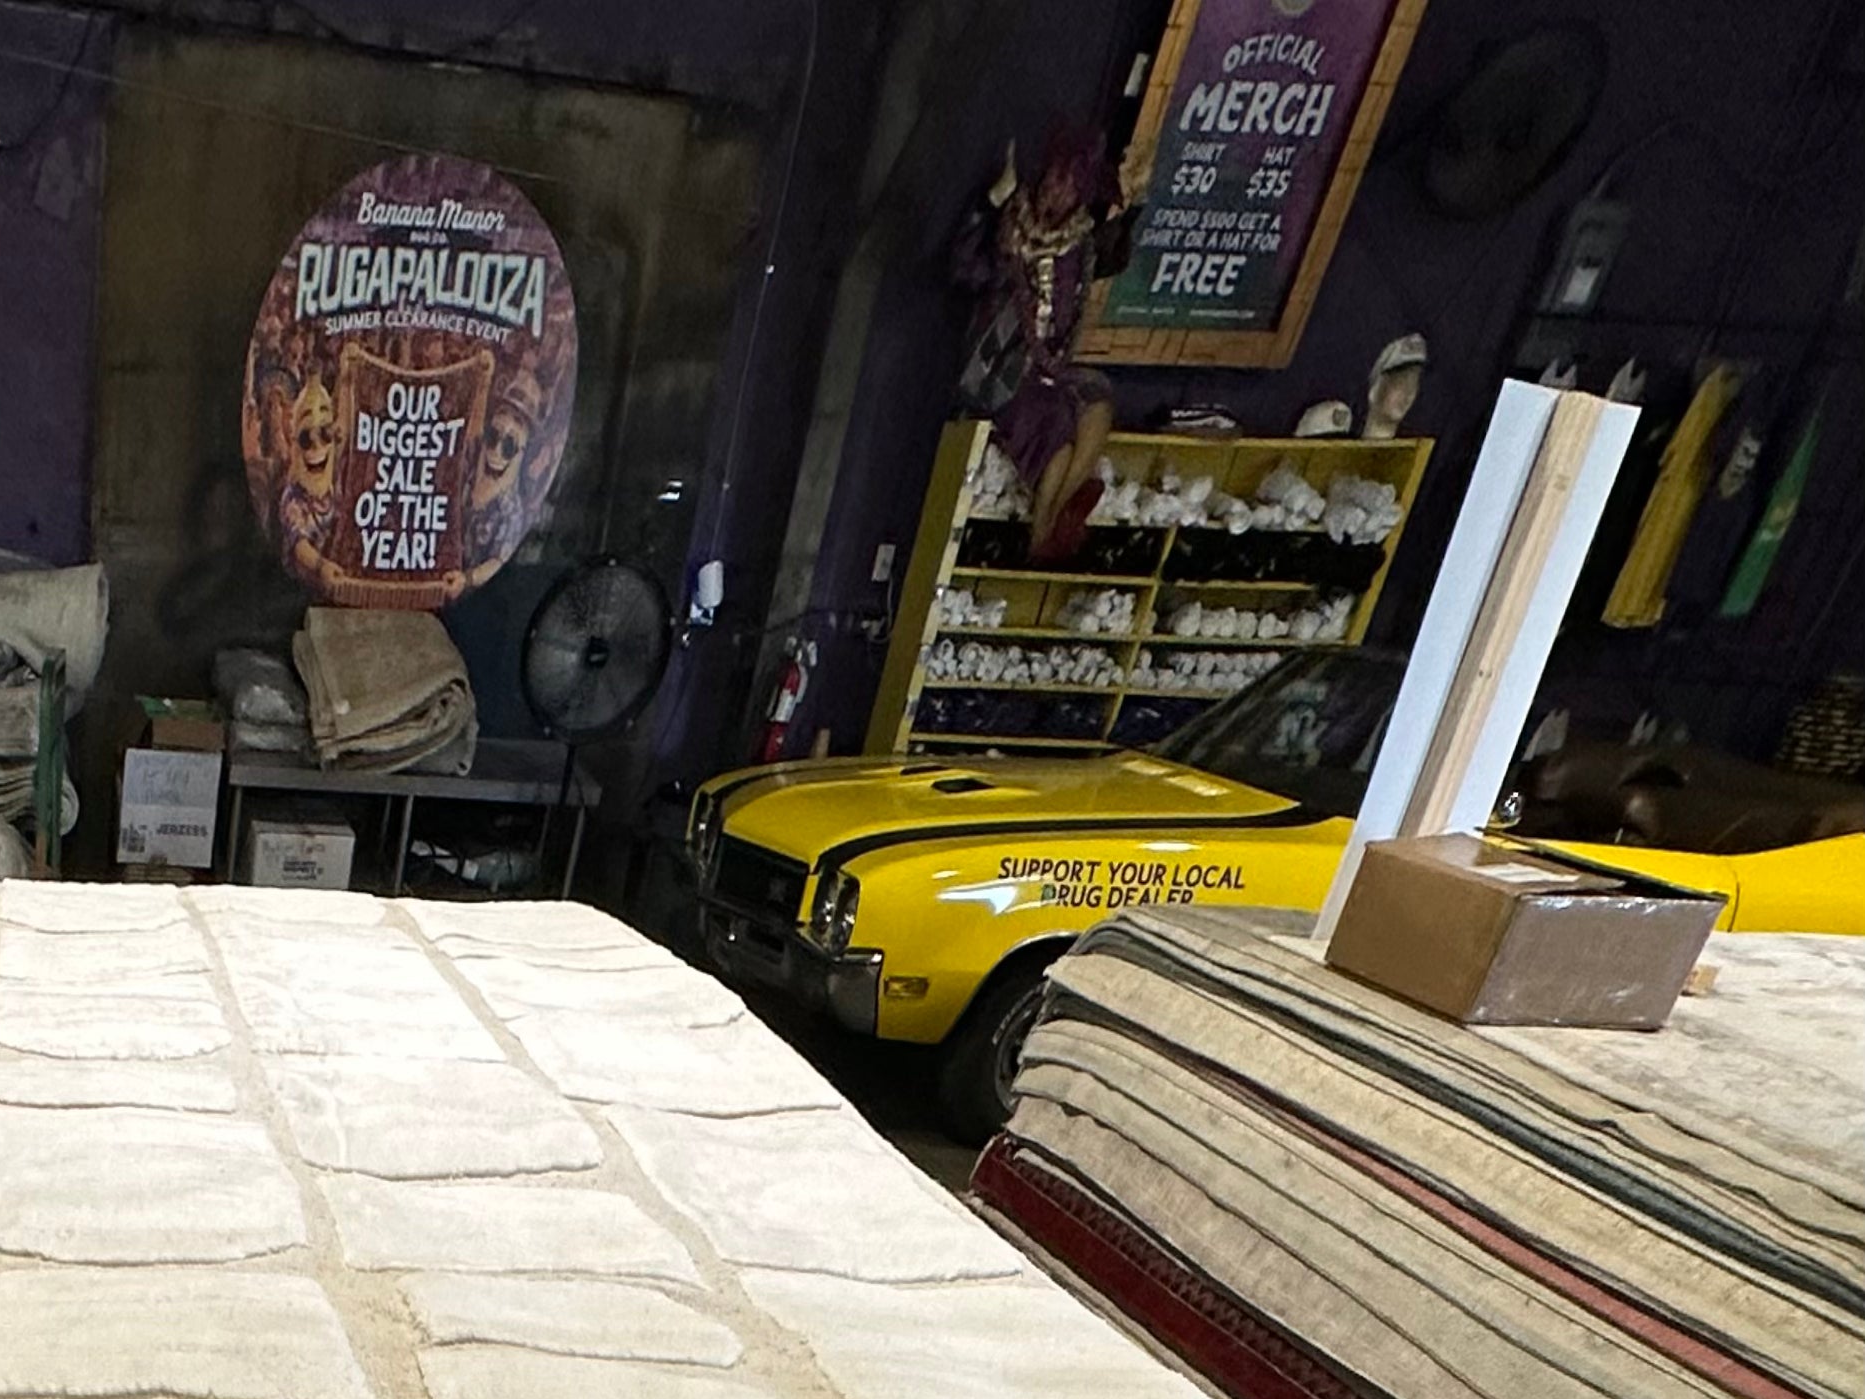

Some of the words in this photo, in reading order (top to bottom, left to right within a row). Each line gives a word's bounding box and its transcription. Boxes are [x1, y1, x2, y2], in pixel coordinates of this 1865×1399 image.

[1223, 33, 1325, 76] OFFICIAL
[1179, 80, 1335, 136] MERCH
[1262, 145, 1297, 165] HAT
[1171, 163, 1217, 195] $30
[1245, 167, 1292, 199] $35
[357, 192, 435, 227] Banana
[435, 198, 506, 232] Manor
[1152, 208, 1199, 228] SPEND
[1238, 212, 1270, 231] GET
[1270, 214, 1282, 231] A
[1206, 231, 1218, 249] A
[1219, 232, 1252, 250] HAT
[1251, 233, 1282, 251] FOR
[295, 242, 546, 339] RUGAPALOOZA
[1151, 252, 1247, 296] FREE
[325, 311, 383, 336] SUMMER
[384, 310, 464, 336] CLEARANCE
[466, 318, 513, 345] EVENT
[387, 382, 441, 421] OUR
[357, 411, 465, 457] BIGGEST
[375, 457, 436, 493] SALE
[355, 491, 391, 527] OF
[398, 495, 448, 531] THE
[361, 529, 436, 569] YEAR!
[998, 857, 1102, 883] SUPPORT
[1108, 861, 1167, 886] YOUR
[1171, 864, 1246, 889] LOCAL
[1041, 884, 1102, 908] DRUG
